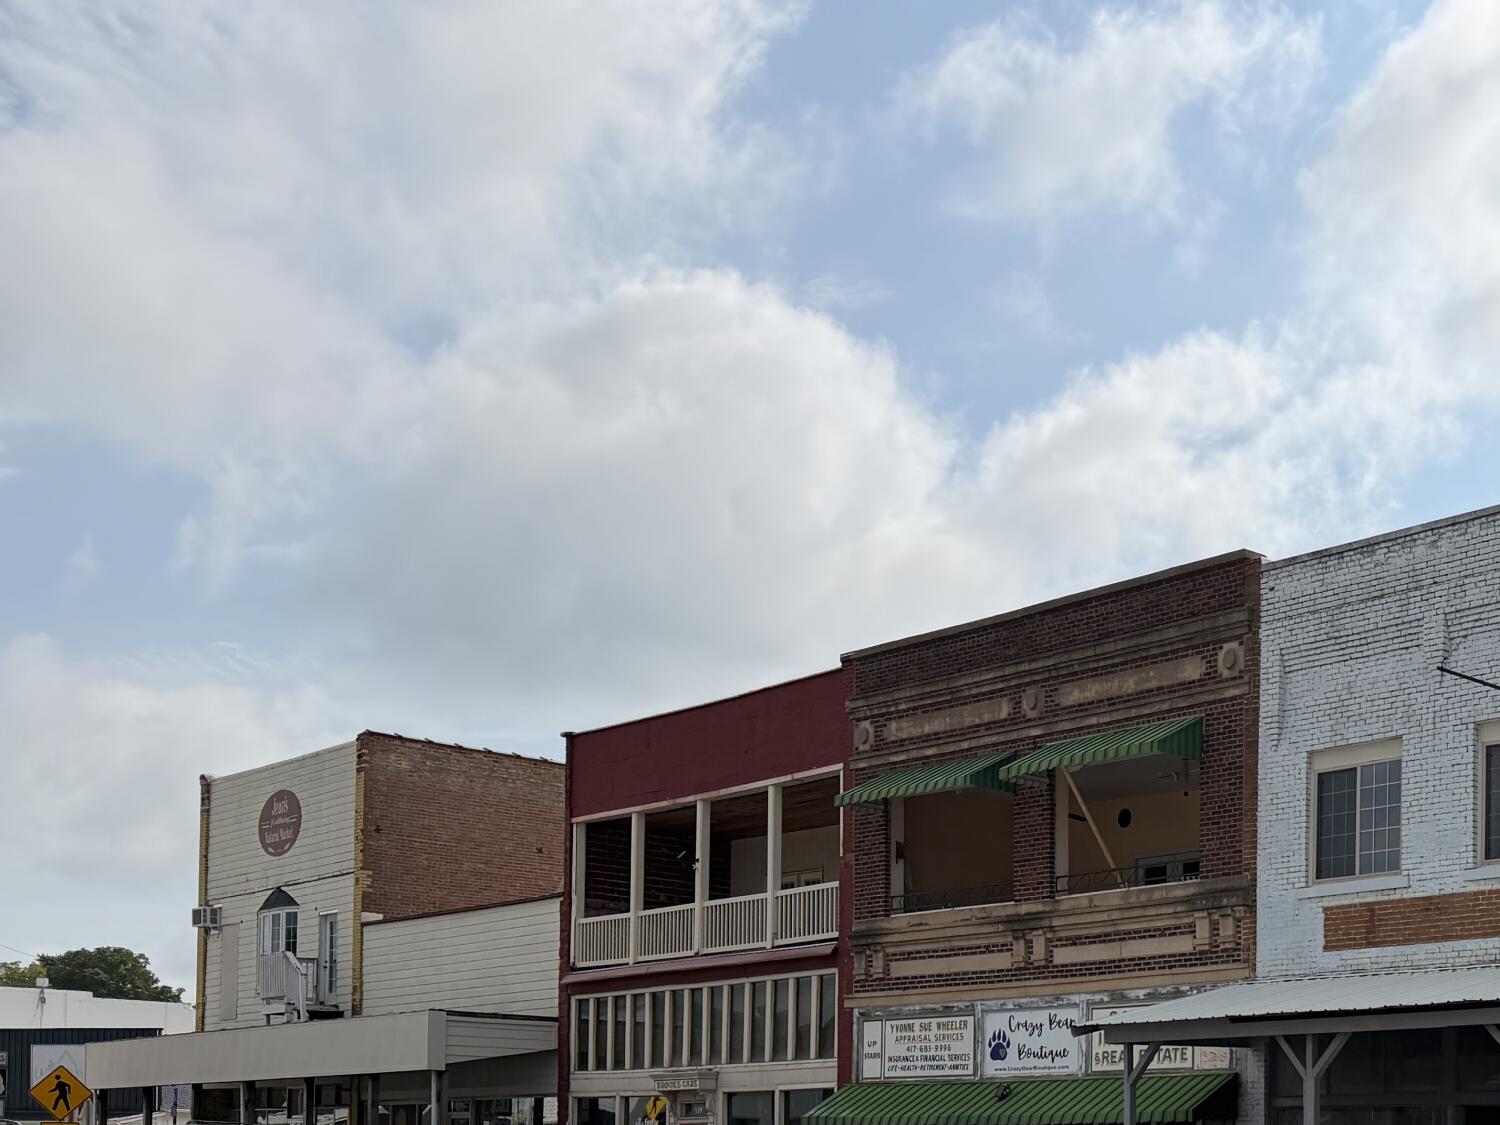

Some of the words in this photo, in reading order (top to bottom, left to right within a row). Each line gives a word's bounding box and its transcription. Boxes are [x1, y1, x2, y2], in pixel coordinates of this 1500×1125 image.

[890, 1022, 915, 1033] YVONNE
[919, 1021, 932, 1032] SUE
[936, 1019, 968, 1031] WHEELER
[1008, 1014, 1044, 1037] Crazy
[1048, 1012, 1076, 1031] Bear
[895, 1034, 931, 1043] APPRAISAL
[934, 1032, 964, 1041] SERVICES
[867, 1040, 877, 1048] UP
[864, 1052, 880, 1060] STAIRS
[920, 1054, 946, 1062] FINANCIAL
[947, 1053, 970, 1062] SERVICES
[1017, 1043, 1069, 1064] Boutique
[994, 1064, 1069, 1072] www.CrazyBearBoutique.com
